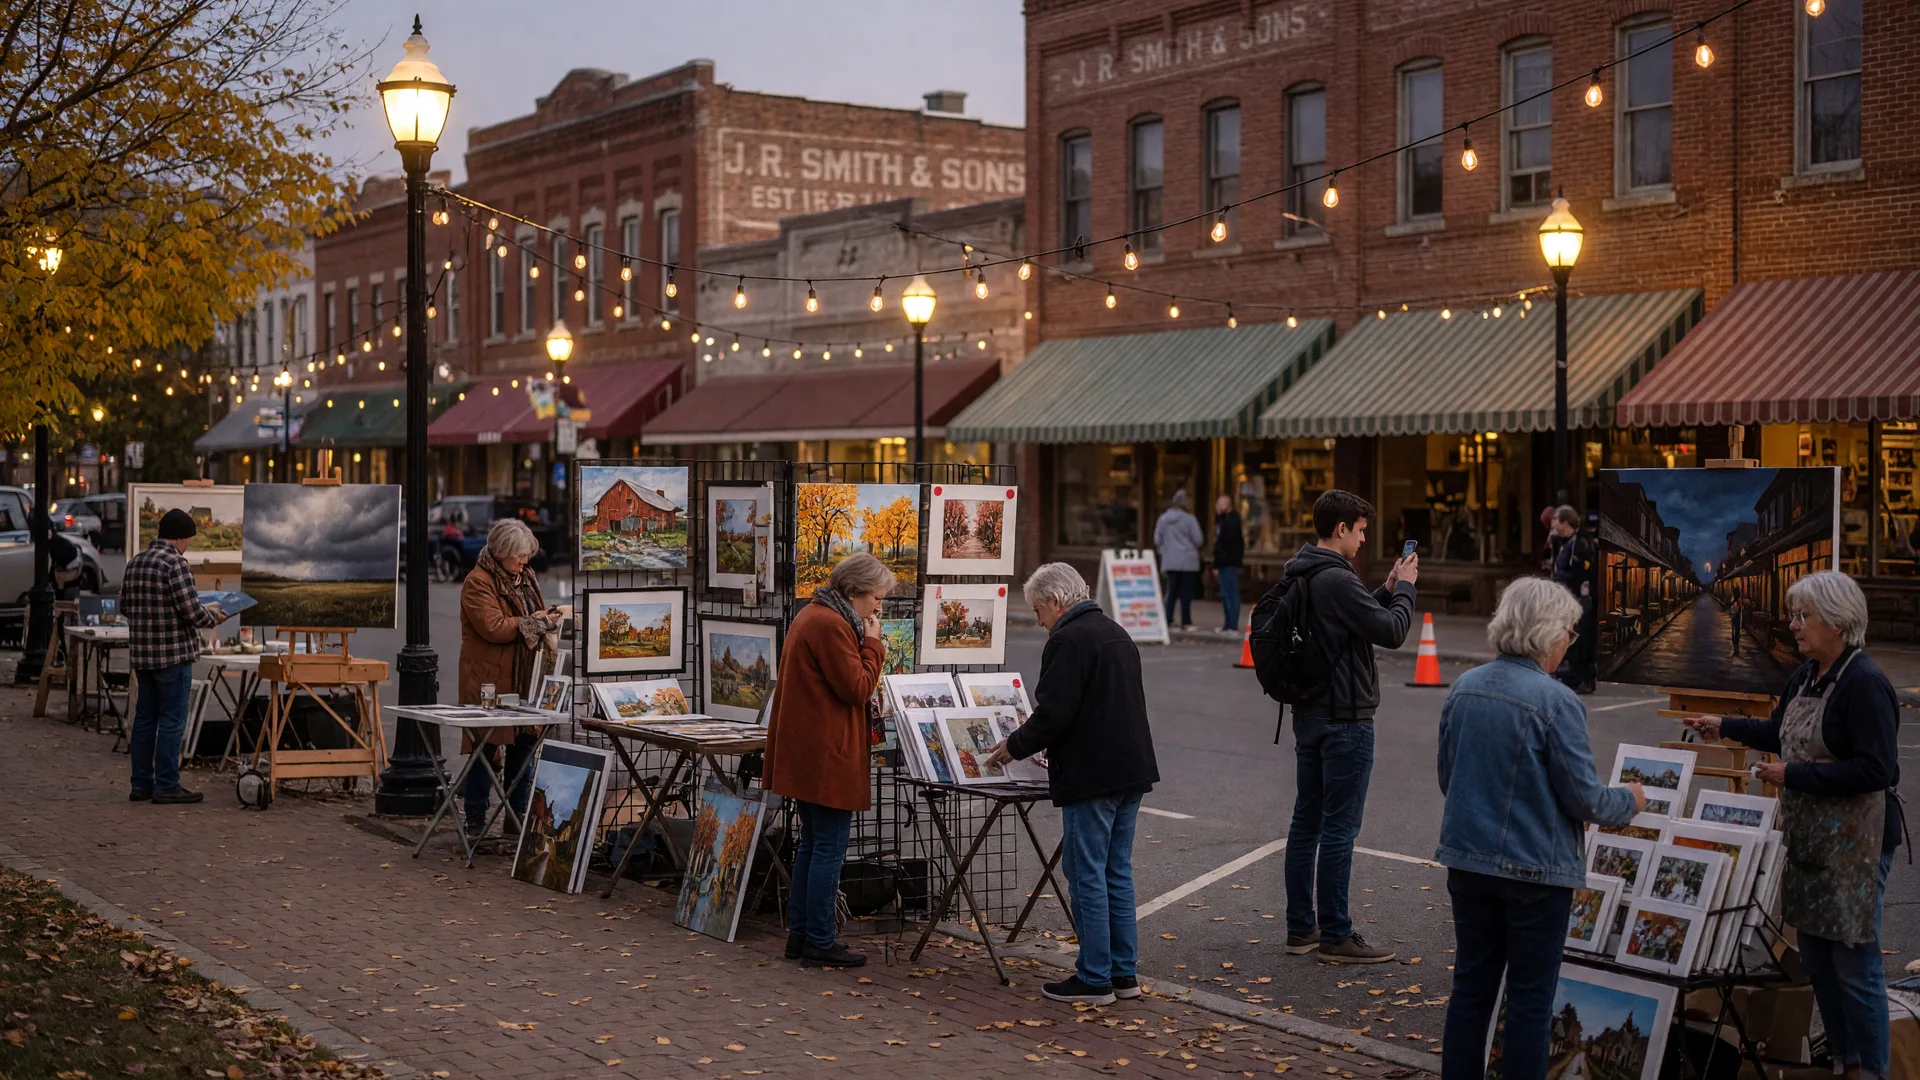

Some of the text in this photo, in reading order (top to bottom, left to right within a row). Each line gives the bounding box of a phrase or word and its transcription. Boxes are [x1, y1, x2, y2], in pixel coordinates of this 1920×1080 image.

[1131, 29, 1202, 74] SMITH
[1212, 25, 1227, 55] &
[1238, 4, 1307, 51] SONS
[801, 147, 903, 188] SMITH
[910, 155, 934, 188] &
[941, 157, 1026, 194] SONS
[751, 185, 797, 211] EST
